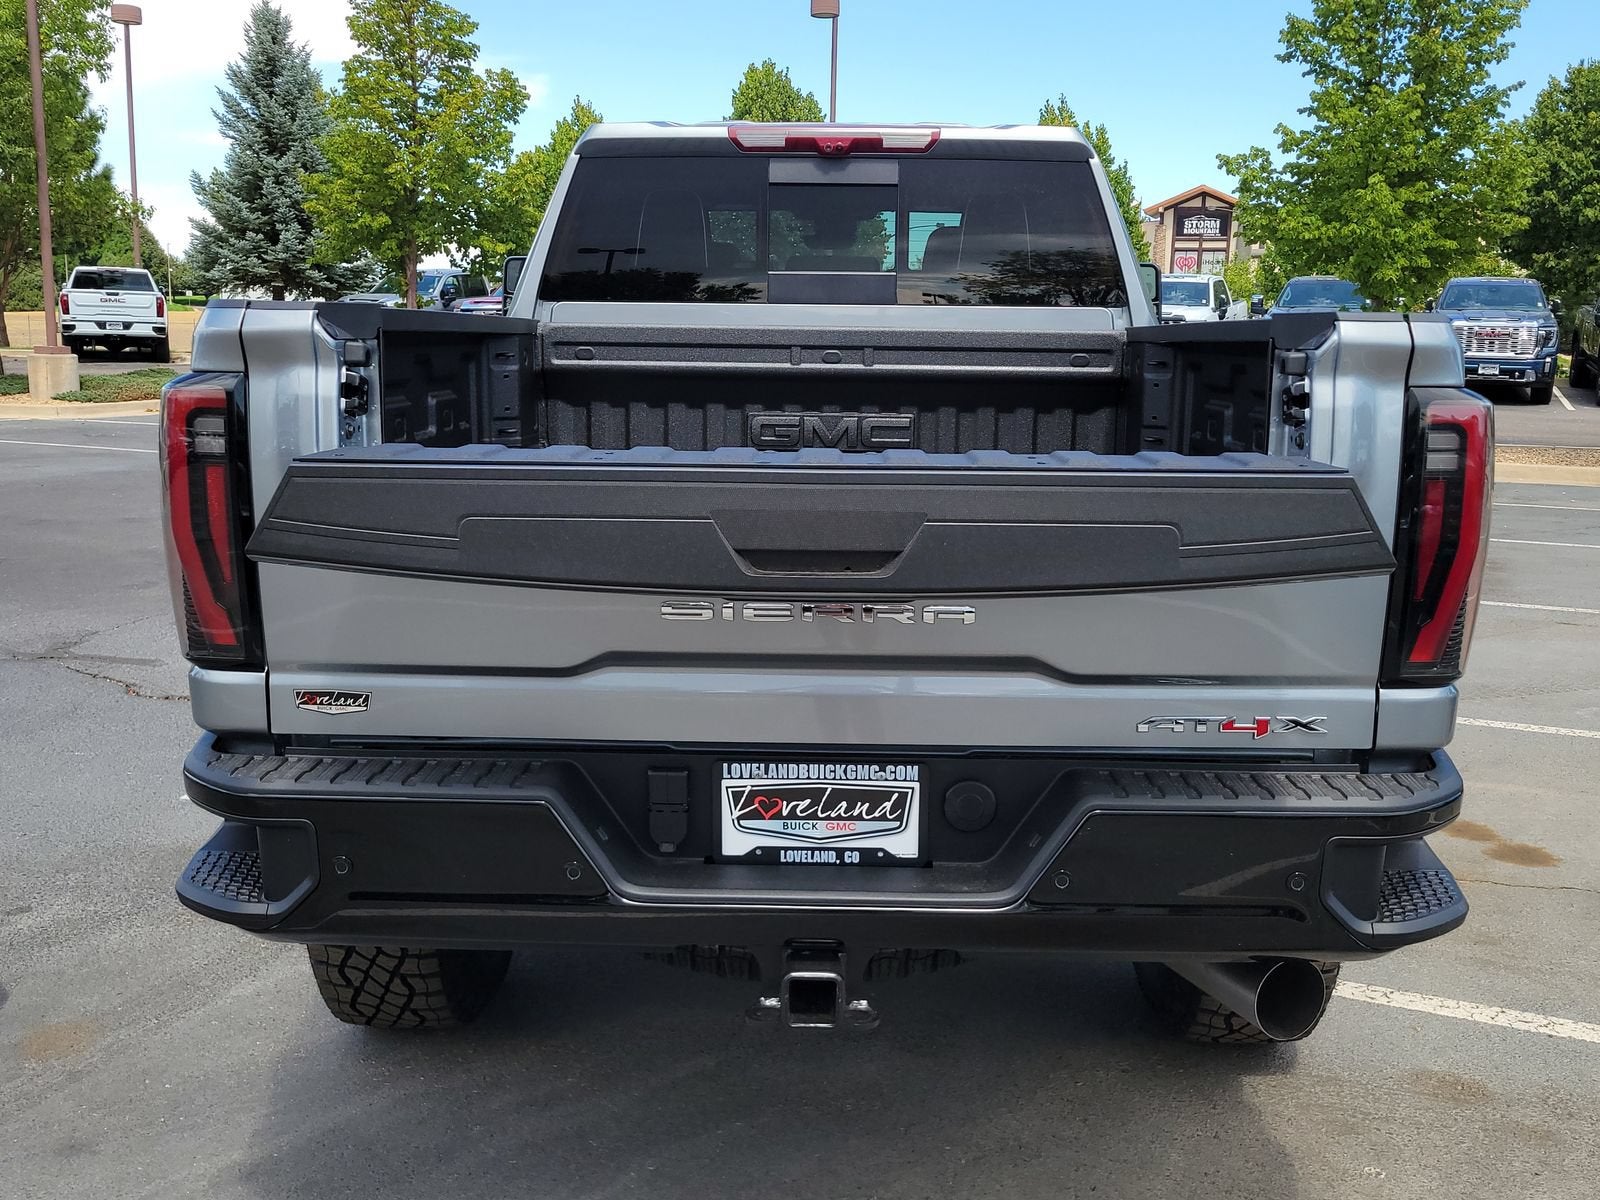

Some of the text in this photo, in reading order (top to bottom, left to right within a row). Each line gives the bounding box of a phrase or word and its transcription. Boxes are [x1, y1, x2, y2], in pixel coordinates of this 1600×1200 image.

[1184, 220, 1220, 229] STORM
[751, 416, 911, 447] GMC
[661, 601, 976, 624] SIERRA
[1137, 716, 1328, 739] AT4X
[722, 763, 919, 781] LOVELANDBUICKGMCCOM
[782, 822, 857, 832] BUICK GMC
[780, 850, 860, 865] LOVELAND, CO
